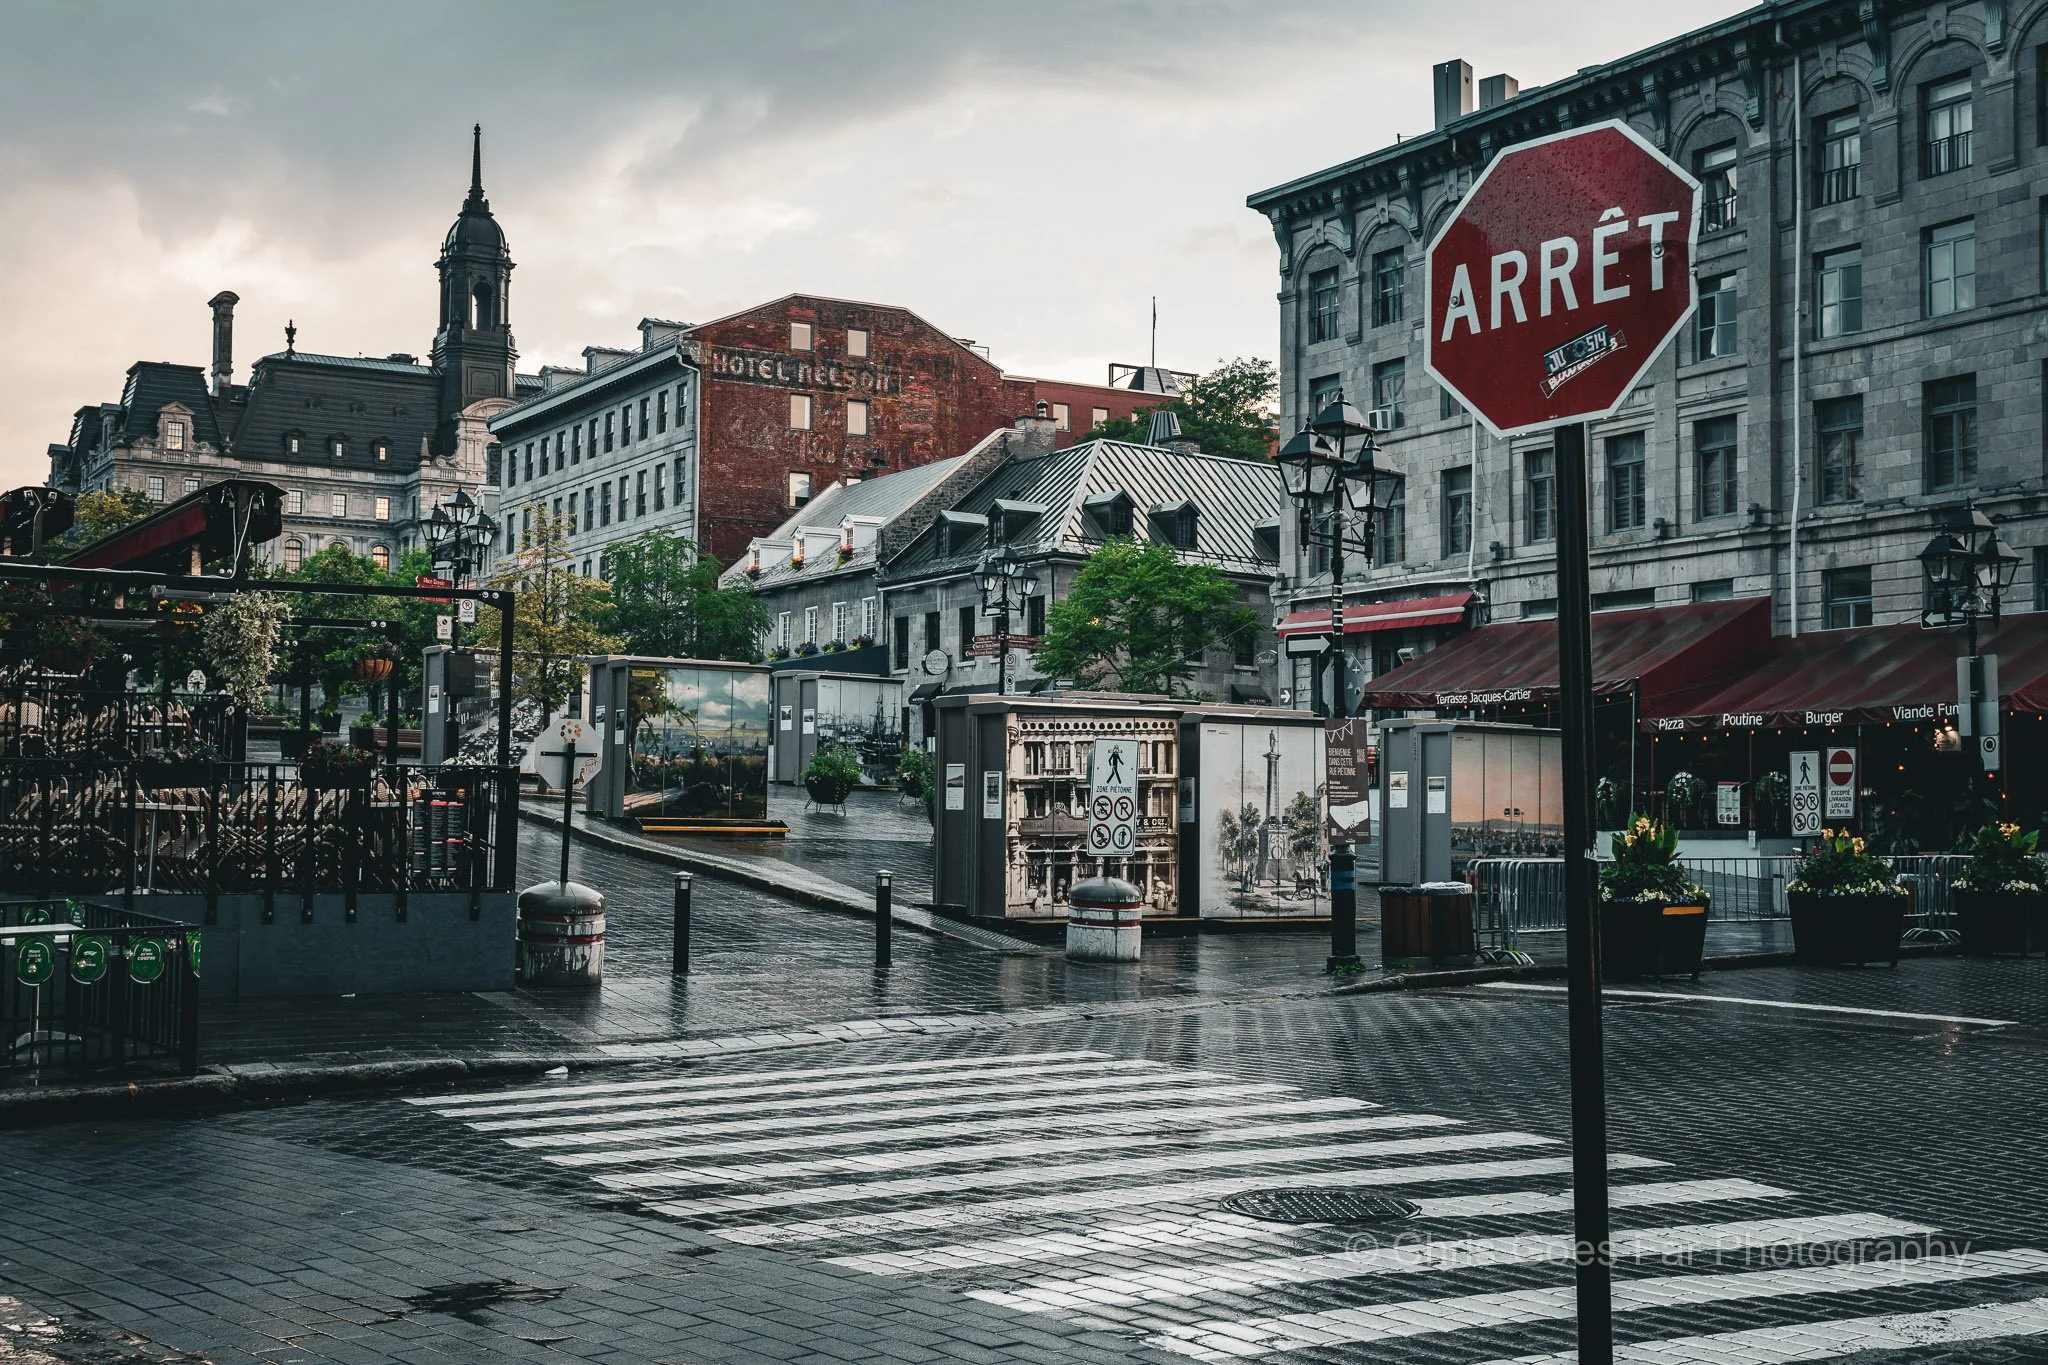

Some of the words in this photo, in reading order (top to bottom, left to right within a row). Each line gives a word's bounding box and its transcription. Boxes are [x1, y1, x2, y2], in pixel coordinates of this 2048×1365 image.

[1441, 206, 1679, 342] ARRÊT
[1435, 693, 1468, 705] Terrasse
[1470, 689, 1532, 705] Jacques-Cartier
[1722, 713, 1763, 726] Poutine
[1805, 711, 1844, 727] Burger
[1892, 703, 1934, 720] Viande
[1658, 718, 1684, 731] Pizza
[1096, 785, 1109, 793] ZONE
[1109, 784, 1133, 794] PIÉTONNE
